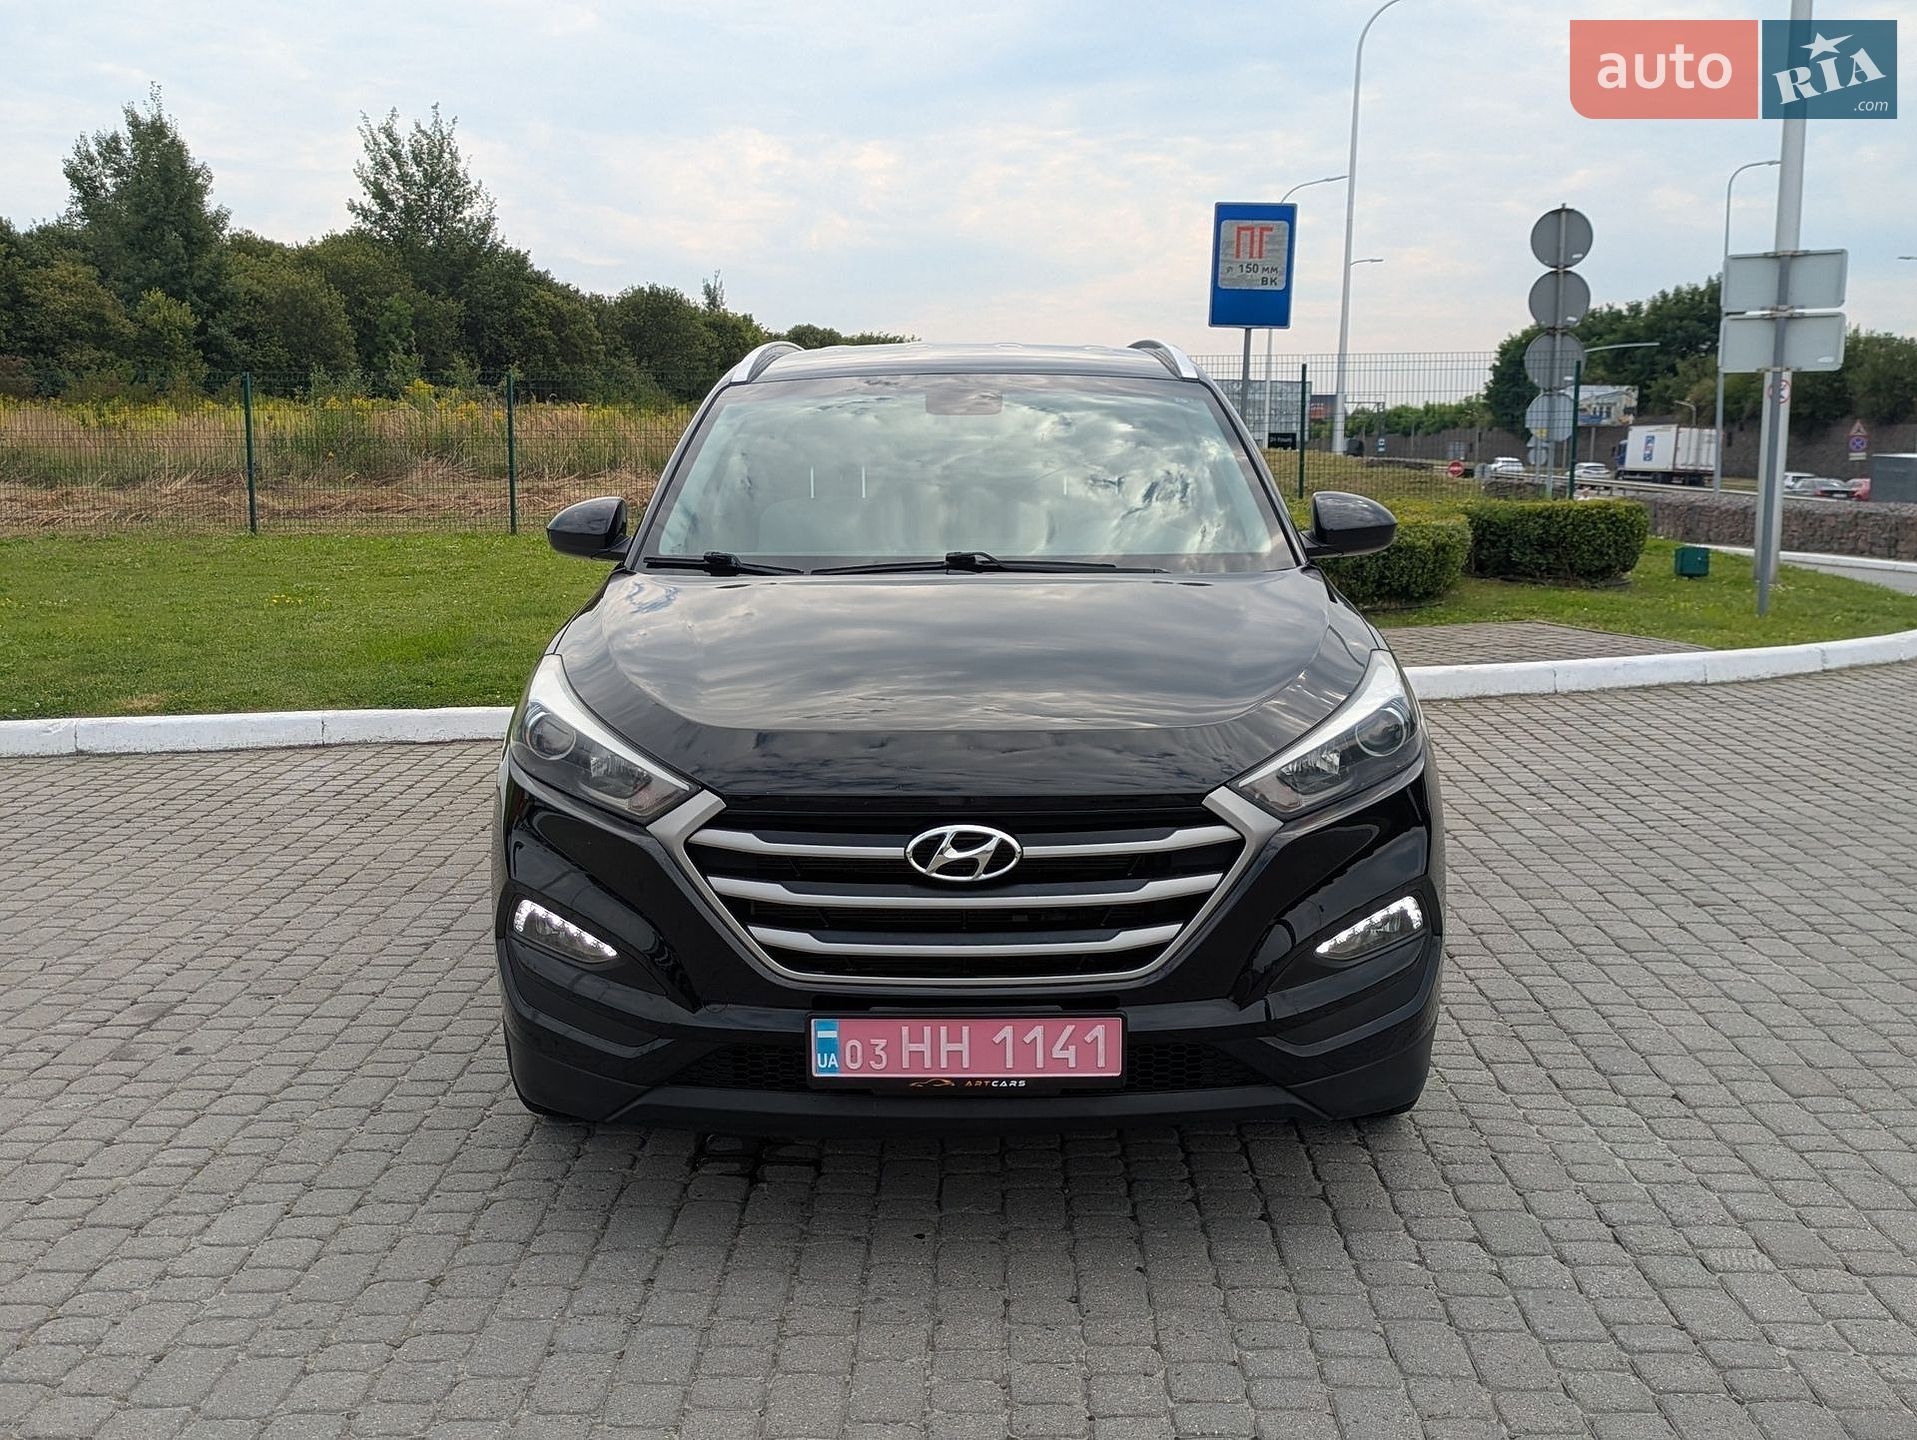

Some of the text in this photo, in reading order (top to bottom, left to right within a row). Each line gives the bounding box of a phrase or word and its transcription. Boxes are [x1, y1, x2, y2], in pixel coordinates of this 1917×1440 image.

[1234, 225, 1274, 259] ПГ
[1239, 263, 1259, 273] 150
[844, 1024, 1106, 1070] 03 HH 1141
[817, 1053, 839, 1069] UA
